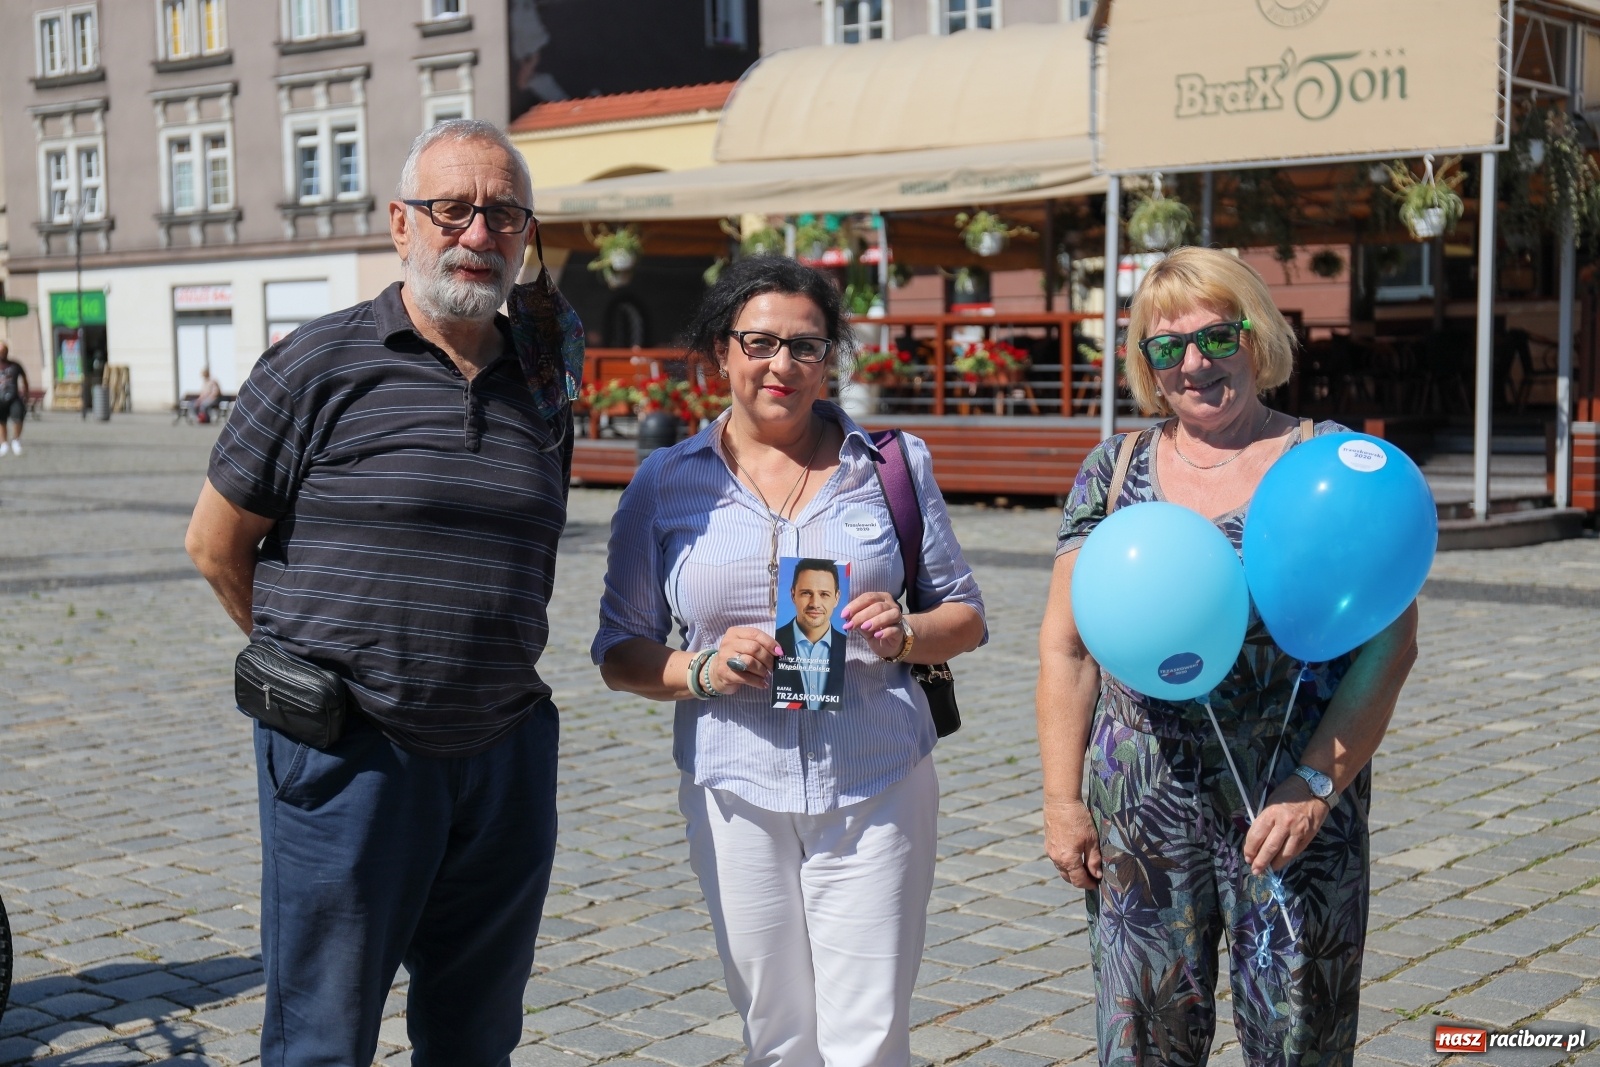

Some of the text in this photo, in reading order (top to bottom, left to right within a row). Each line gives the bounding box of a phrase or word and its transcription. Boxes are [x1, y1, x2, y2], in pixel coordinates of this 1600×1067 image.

[1354, 452, 1372, 460] 2020
[795, 656, 830, 664] Prezydent
[776, 692, 840, 703] TRZASKOWSKI
